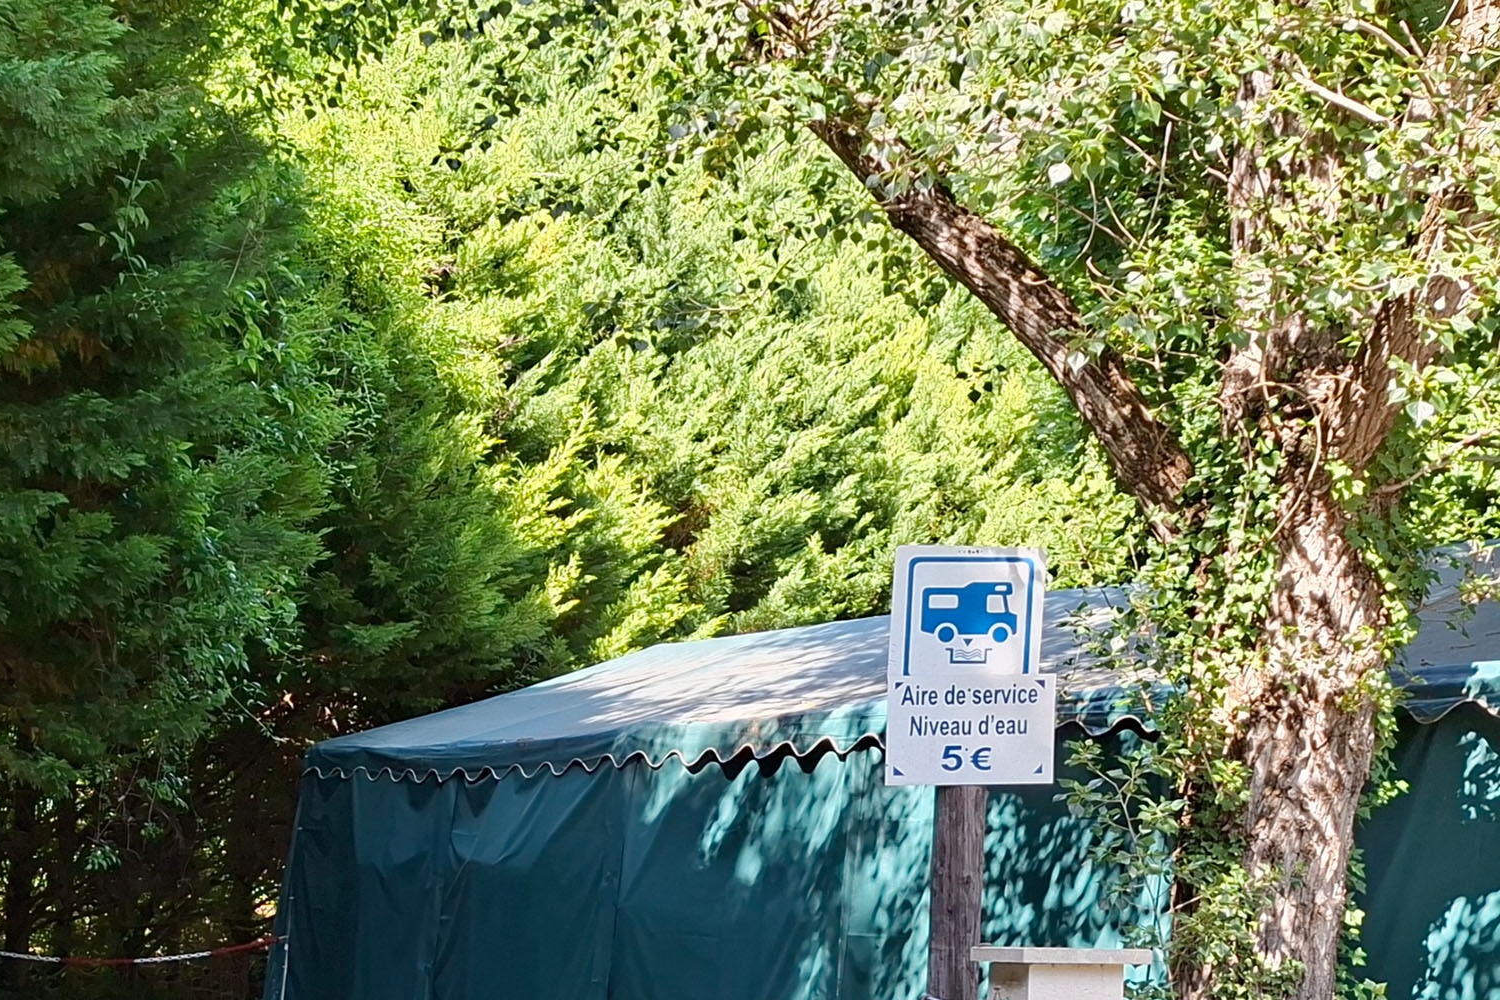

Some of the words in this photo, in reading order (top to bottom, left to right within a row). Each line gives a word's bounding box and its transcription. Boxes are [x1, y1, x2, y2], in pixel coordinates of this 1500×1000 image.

[901, 685, 938, 706] Aire
[944, 684, 966, 705] de
[972, 683, 1038, 704] service
[909, 716, 972, 736] Niveau
[941, 745, 963, 771] 5
[970, 746, 992, 771] €
